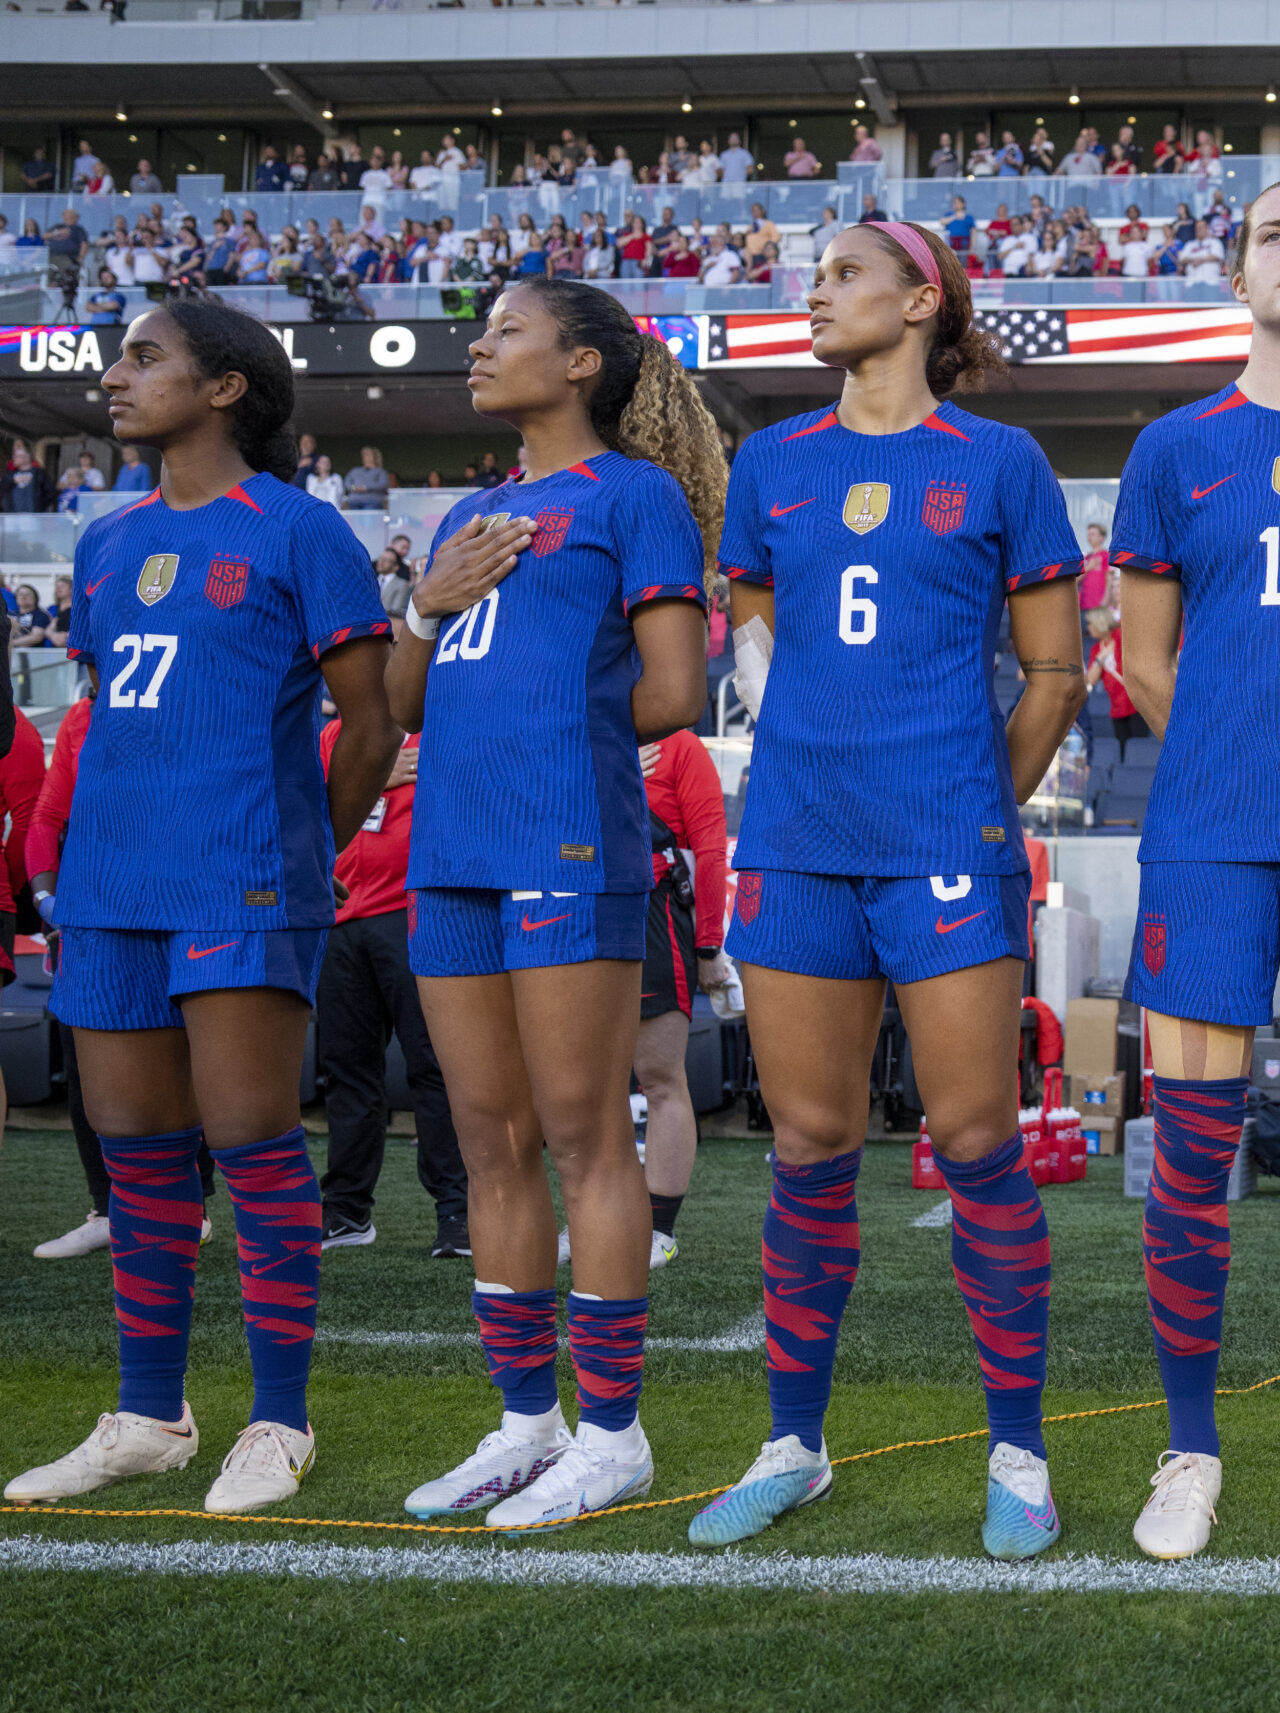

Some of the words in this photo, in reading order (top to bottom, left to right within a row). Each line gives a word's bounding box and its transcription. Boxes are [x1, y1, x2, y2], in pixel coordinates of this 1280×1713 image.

[20, 331, 103, 371] USA
[928, 490, 963, 511] USA
[537, 512, 569, 532] USA
[854, 514, 874, 522] FIFA
[212, 563, 246, 583] USA
[146, 585, 162, 593] FIFA
[838, 564, 879, 645] 6
[436, 587, 500, 665] 20
[109, 633, 178, 709] 27
[739, 875, 761, 896] USA
[1145, 926, 1164, 946] USA
